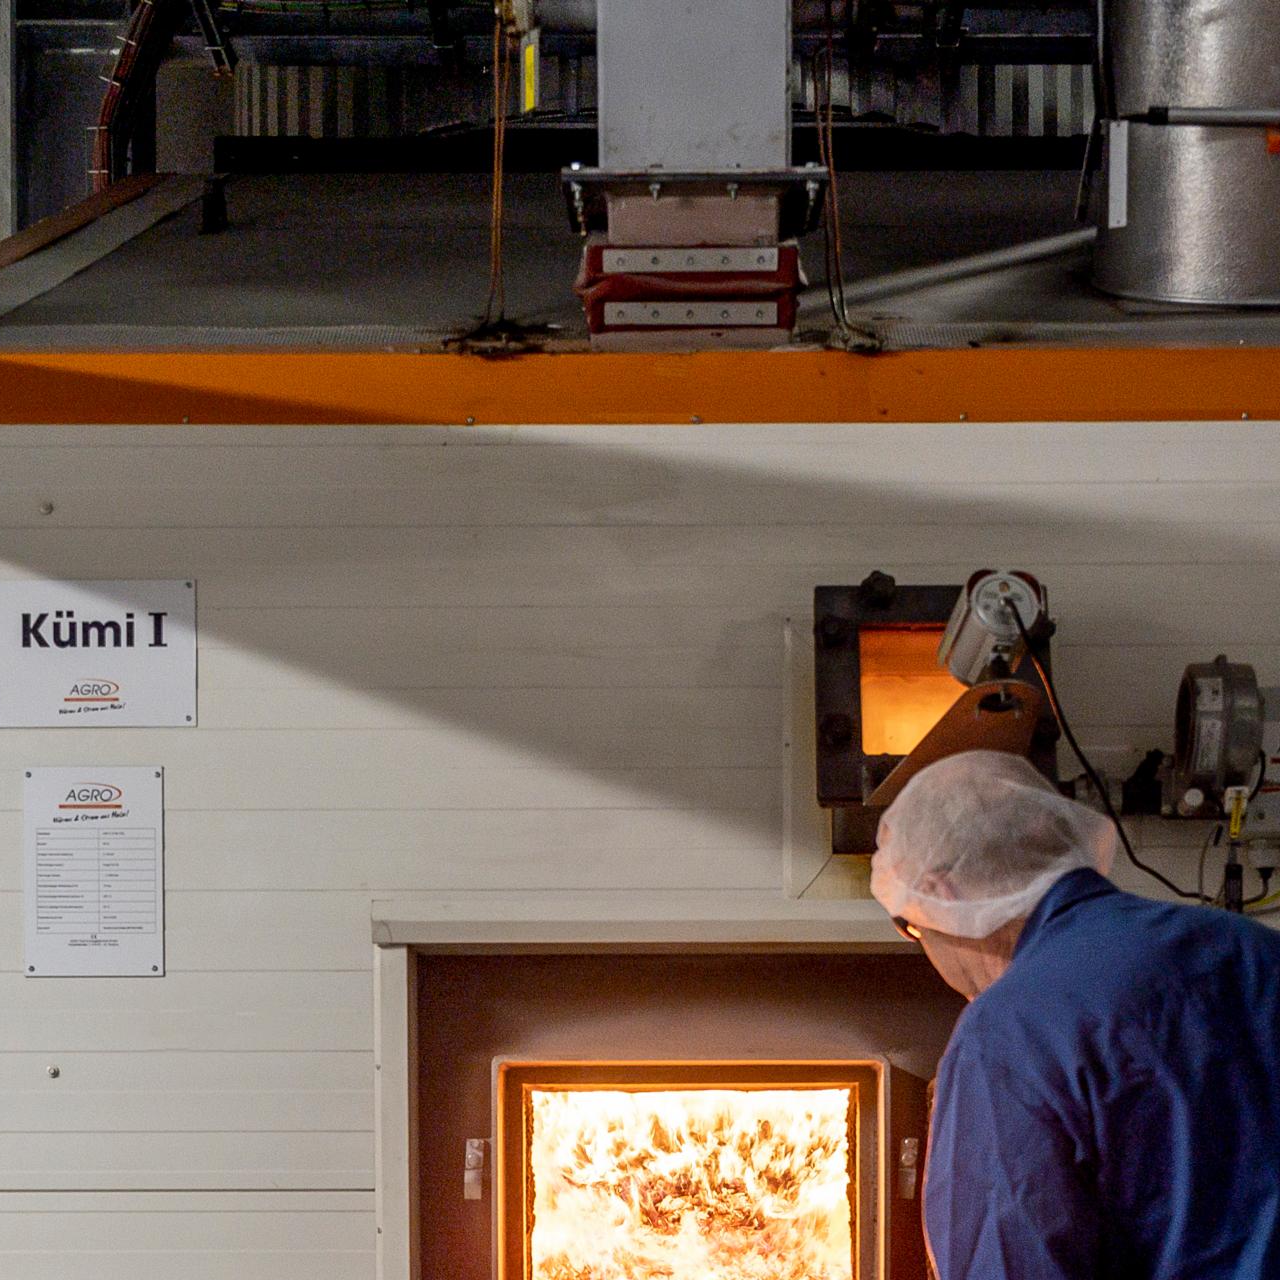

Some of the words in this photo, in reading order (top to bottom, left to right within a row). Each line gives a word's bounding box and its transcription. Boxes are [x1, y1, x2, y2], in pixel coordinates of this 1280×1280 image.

[21, 610, 135, 648] Kümi
[70, 684, 112, 696] AGRO
[65, 788, 114, 802] AGRO
